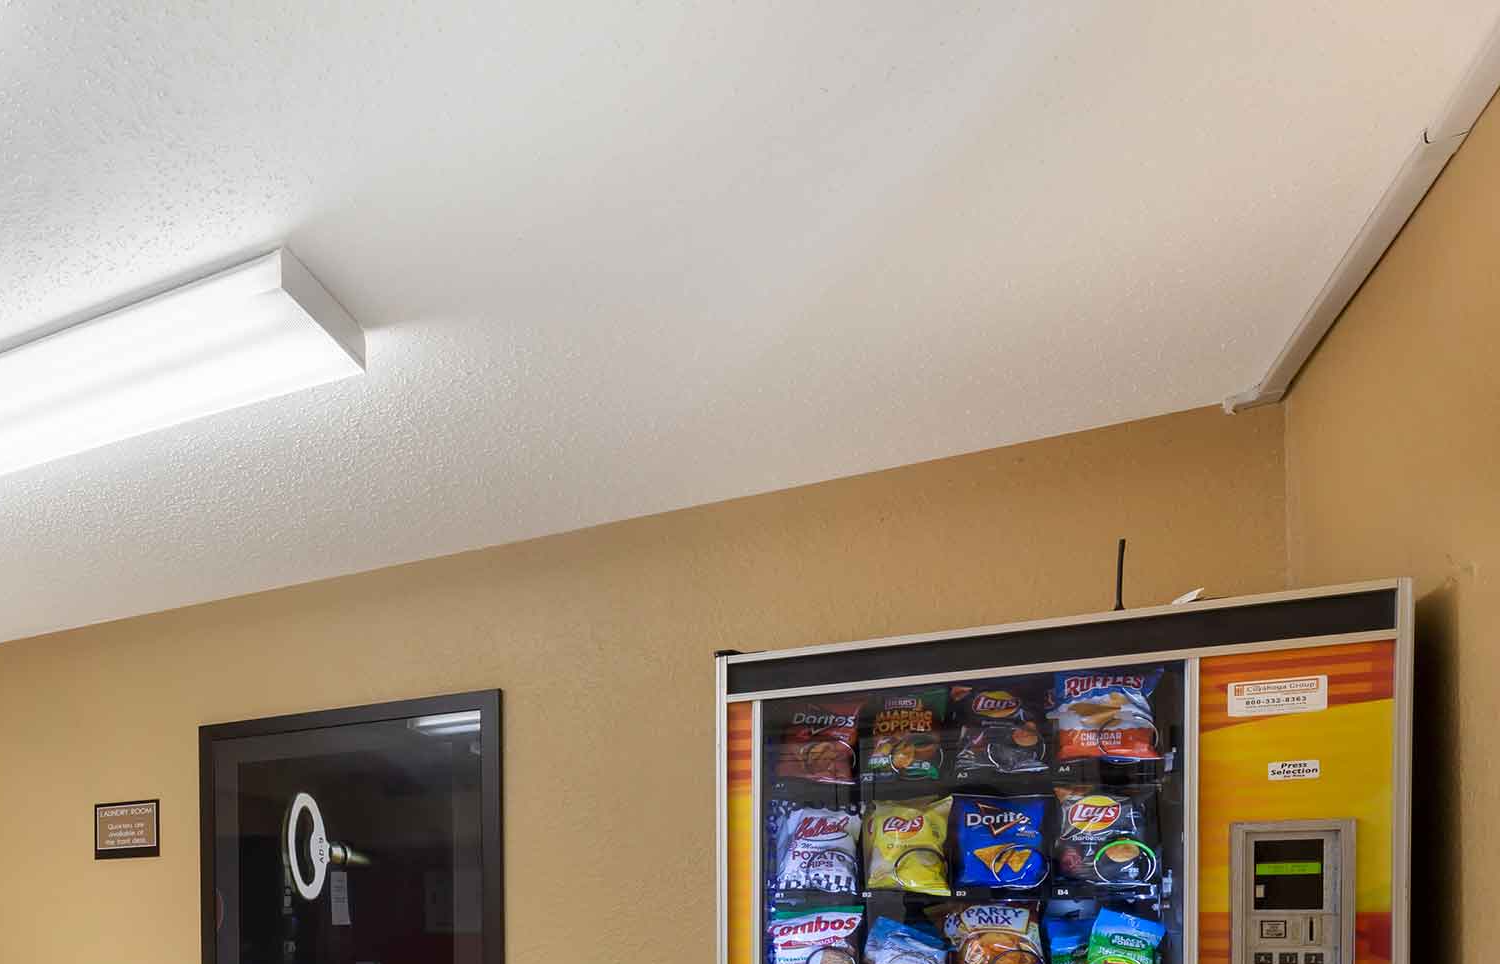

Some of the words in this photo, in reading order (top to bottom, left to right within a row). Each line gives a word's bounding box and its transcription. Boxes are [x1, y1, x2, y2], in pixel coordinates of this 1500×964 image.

[1065, 675, 1143, 697] RUFFLES
[793, 712, 856, 728] Doritos
[1270, 767, 1318, 776] Selection
[99, 808, 129, 817] LAUNDRY
[130, 807, 152, 815] ROOM
[791, 850, 846, 862] POTATO
[799, 860, 834, 869] CHIPS
[964, 907, 1023, 920] PARTY
[978, 915, 1013, 926] MIX
[768, 916, 858, 938] Combos
